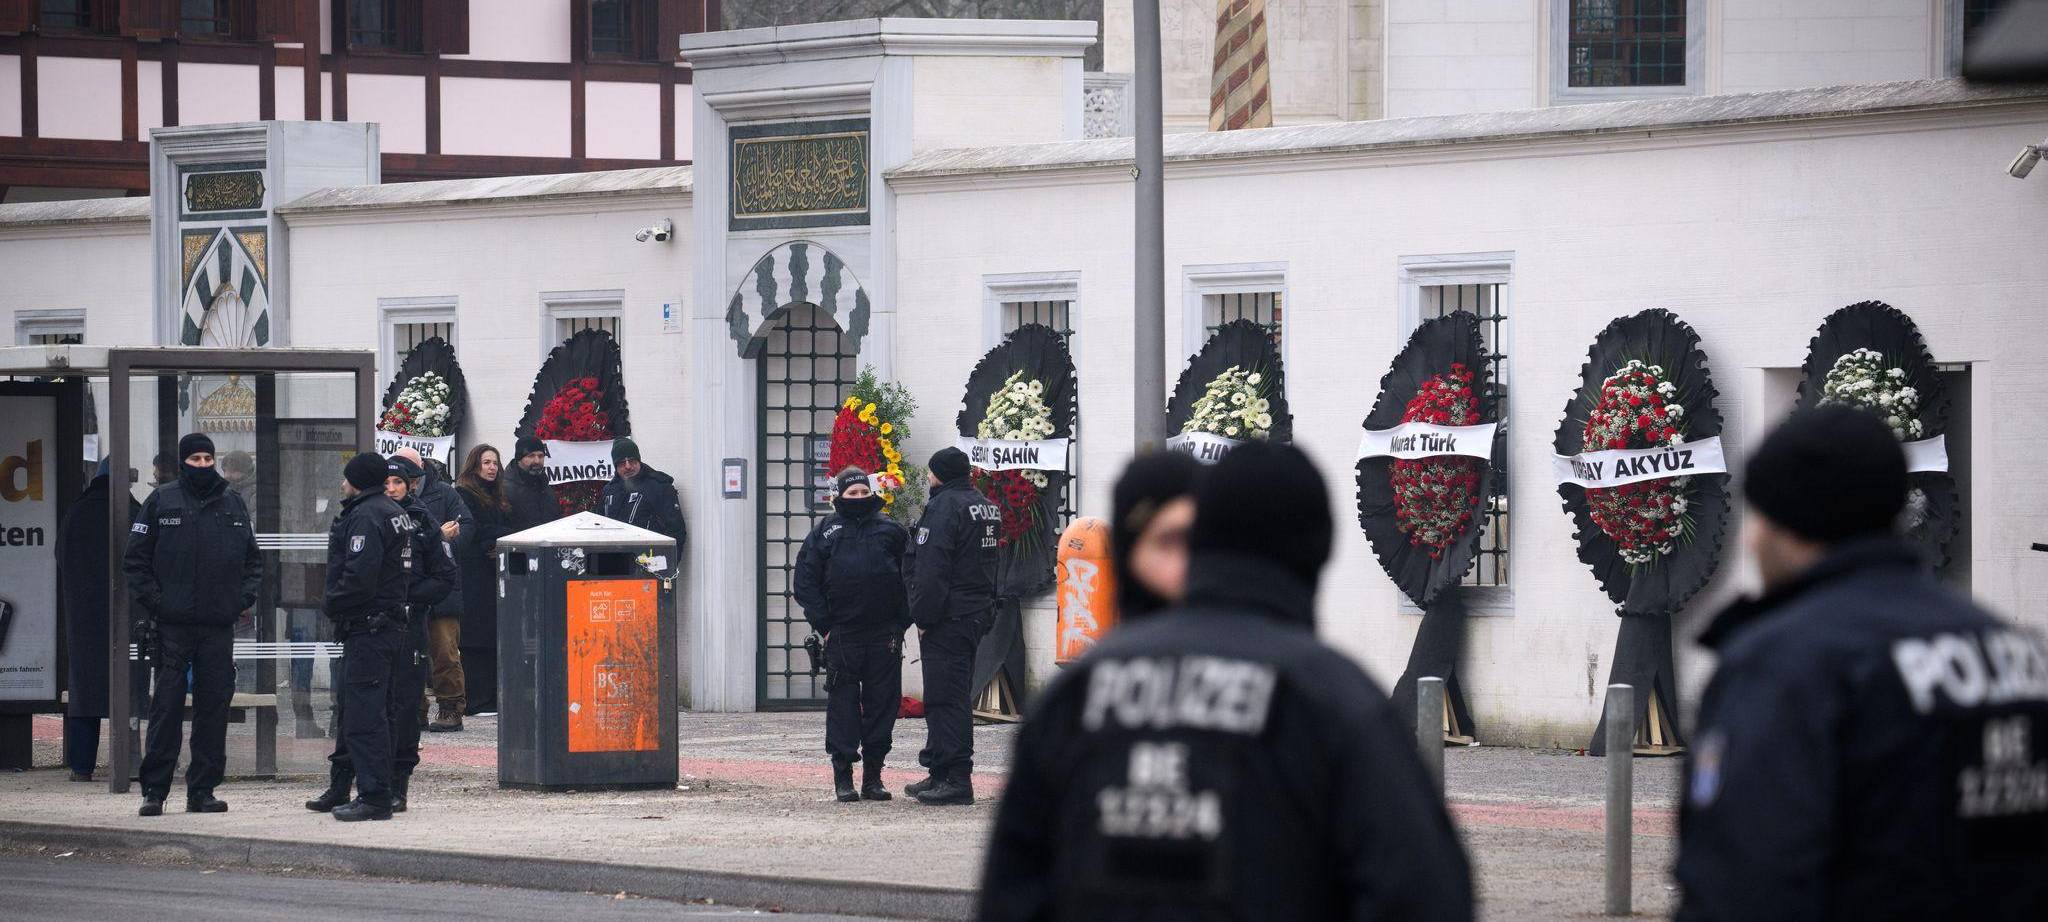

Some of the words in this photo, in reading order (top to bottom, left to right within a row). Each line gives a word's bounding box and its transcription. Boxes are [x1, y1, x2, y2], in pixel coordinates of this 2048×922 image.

[993, 441, 1039, 469] ŞAHİN
[1420, 433, 1457, 452] Türk
[545, 459, 613, 482] MANOĞL
[1614, 447, 1694, 478] AKYÜZ
[969, 504, 1002, 521] POLIZE
[1084, 657, 1277, 735] POLIZEI
[1129, 741, 1188, 786] BE
